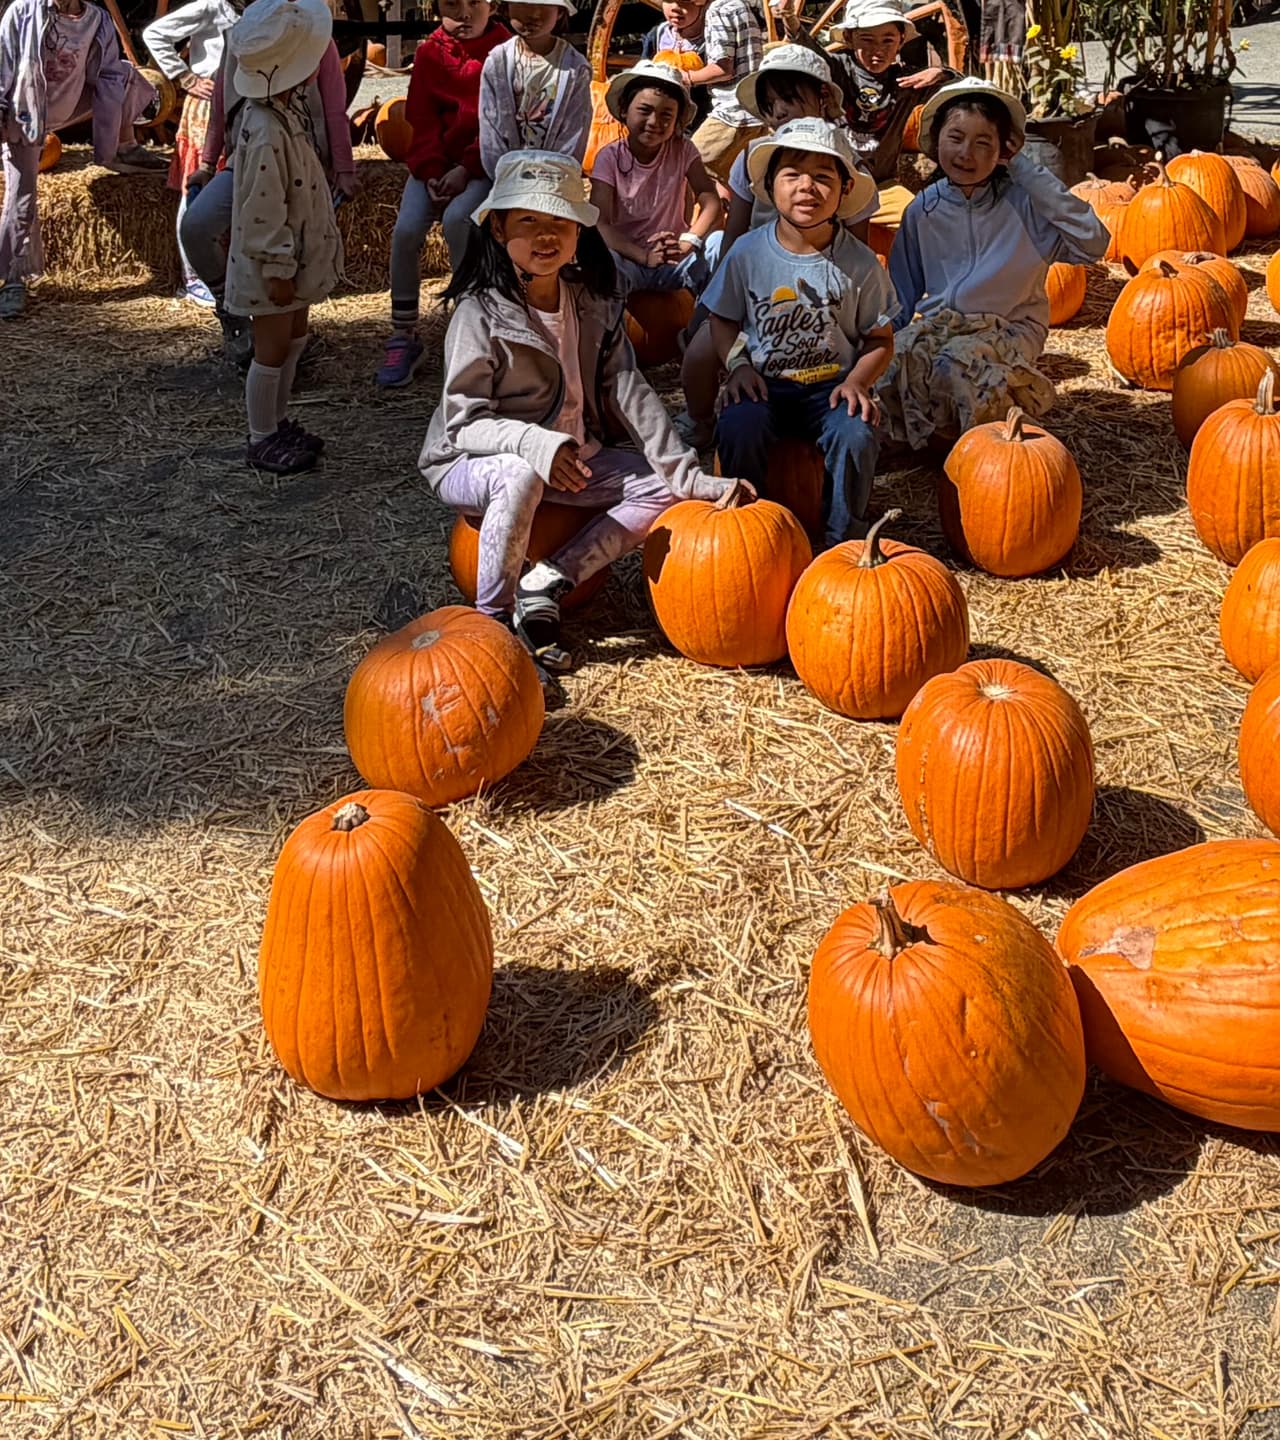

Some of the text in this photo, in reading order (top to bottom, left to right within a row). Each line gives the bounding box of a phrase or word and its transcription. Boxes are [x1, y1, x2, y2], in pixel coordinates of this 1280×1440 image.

[755, 303, 830, 348] Eagles
[784, 333, 824, 355] Soar
[760, 348, 839, 377] Together
